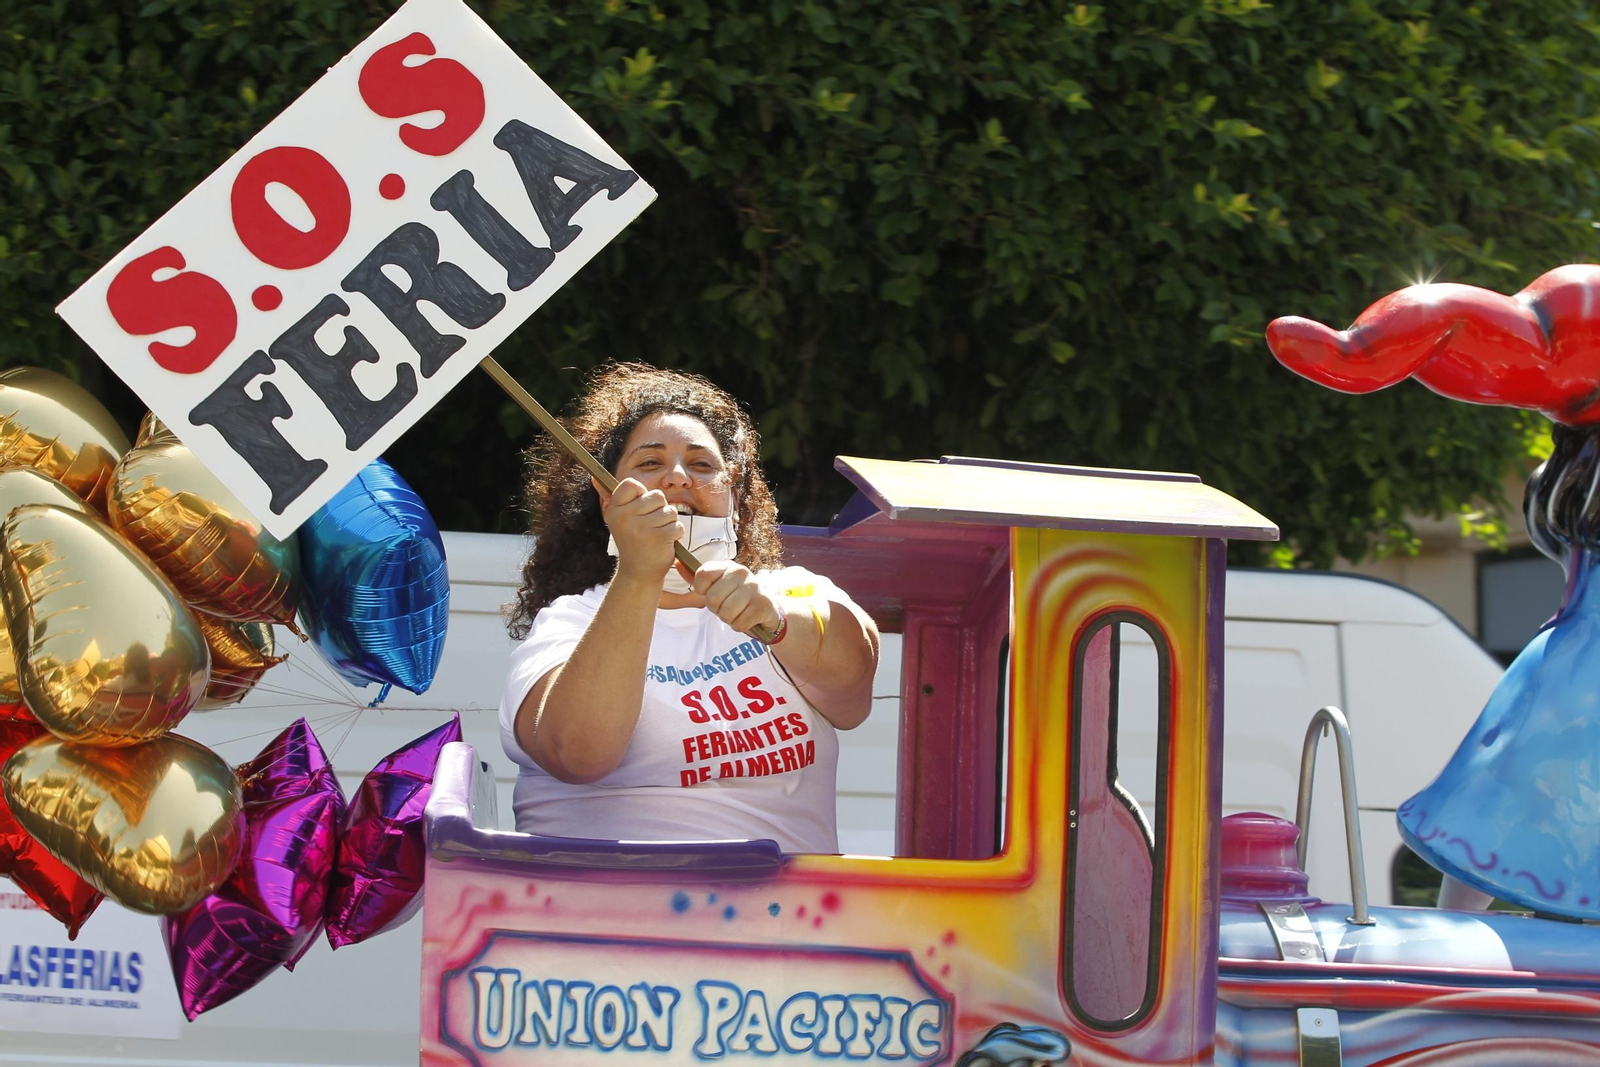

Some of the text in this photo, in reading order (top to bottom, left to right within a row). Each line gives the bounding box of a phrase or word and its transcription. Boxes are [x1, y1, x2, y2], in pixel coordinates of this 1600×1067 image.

[106, 31, 486, 374] S.O.S
[188, 118, 640, 516] FERIA
[646, 637, 767, 687] #SALVALASFERI
[681, 676, 787, 724] S.O.S.
[682, 712, 809, 764] FERIANTES
[718, 740, 816, 778] ALMERIA
